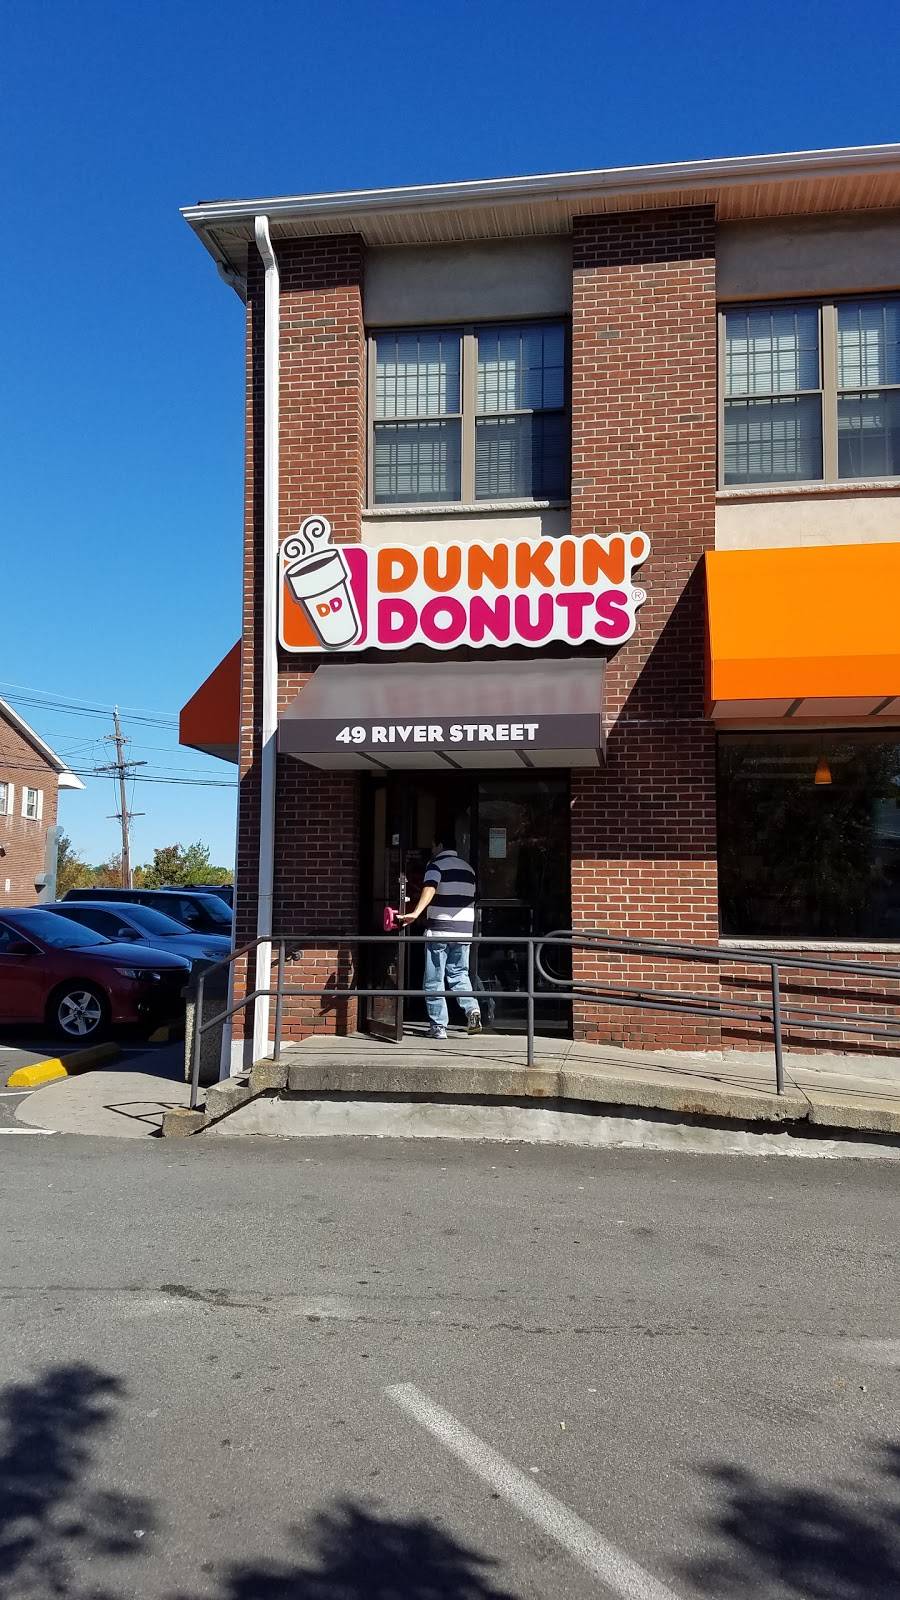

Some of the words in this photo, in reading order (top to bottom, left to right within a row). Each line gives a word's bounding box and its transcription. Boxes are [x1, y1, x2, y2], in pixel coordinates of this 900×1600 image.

[378, 537, 644, 593] DUNKIN'
[316, 597, 342, 618] DD
[378, 590, 629, 644] DONUTS
[335, 726, 367, 744] 49
[371, 724, 444, 743] RIVER
[450, 723, 539, 742] STREET
